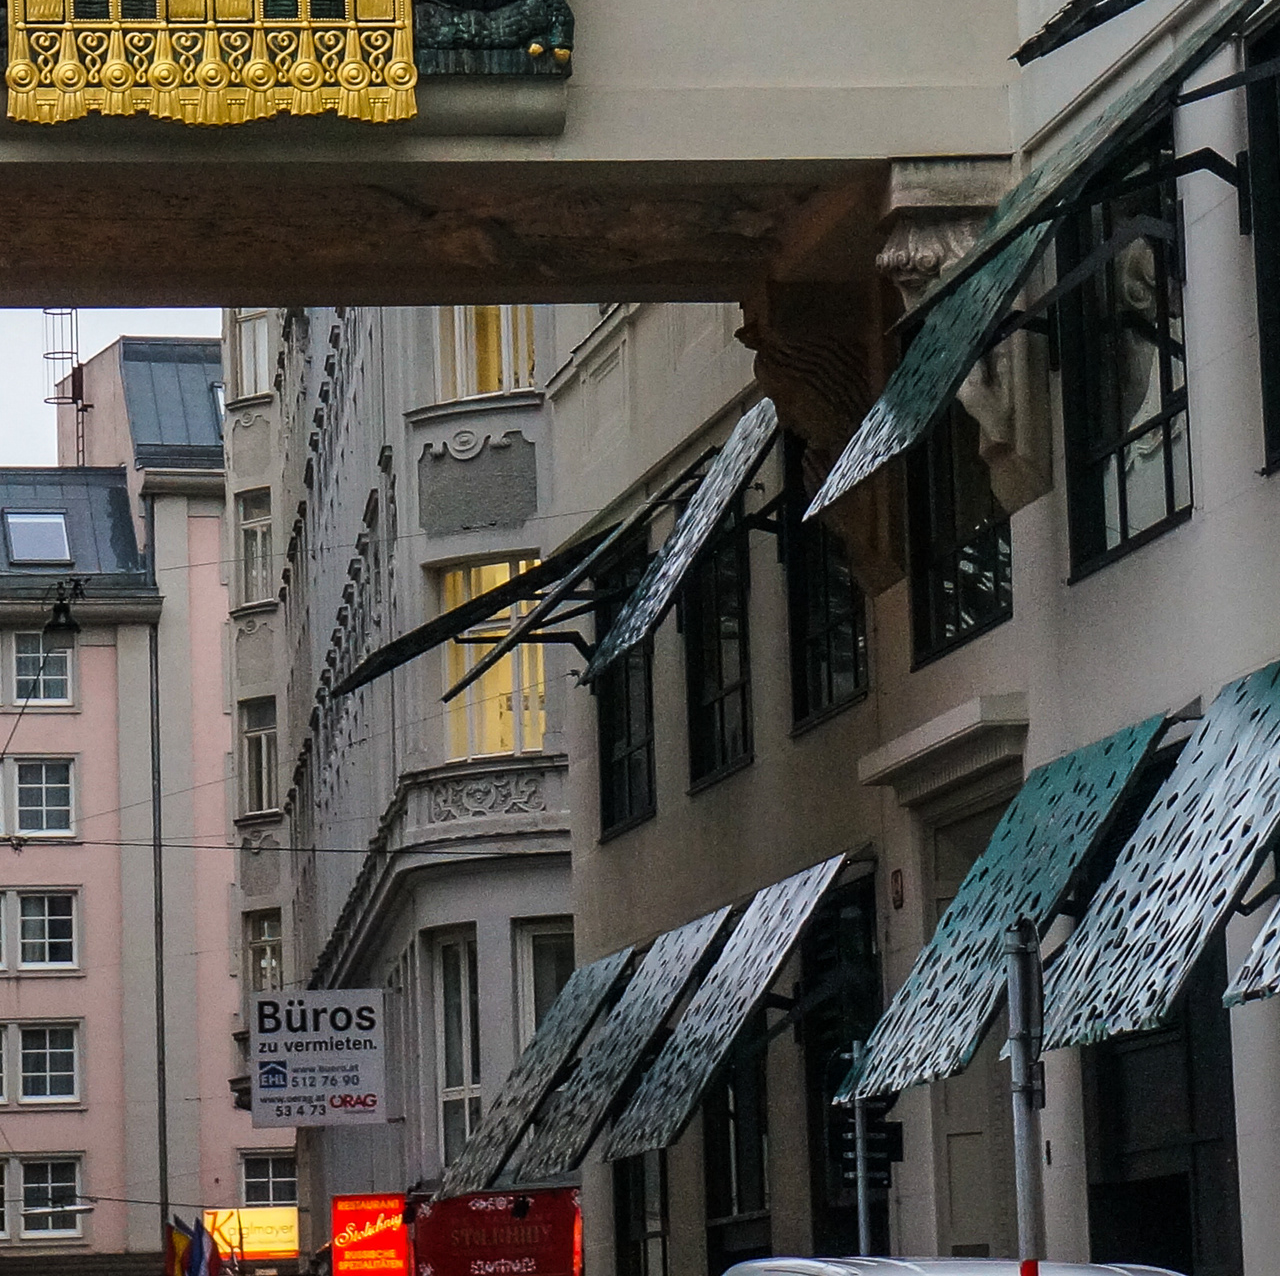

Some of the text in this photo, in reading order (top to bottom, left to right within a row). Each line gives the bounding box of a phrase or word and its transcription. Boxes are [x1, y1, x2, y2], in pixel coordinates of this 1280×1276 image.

[257, 999, 377, 1034] Büros
[259, 1036, 378, 1053] zu vermieten.
[291, 1076, 317, 1088] 512
[322, 1075, 339, 1087] 76
[342, 1074, 360, 1086] 90
[275, 1104, 326, 1117] 53 4 73
[338, 1199, 400, 1211] RESTAURANT
